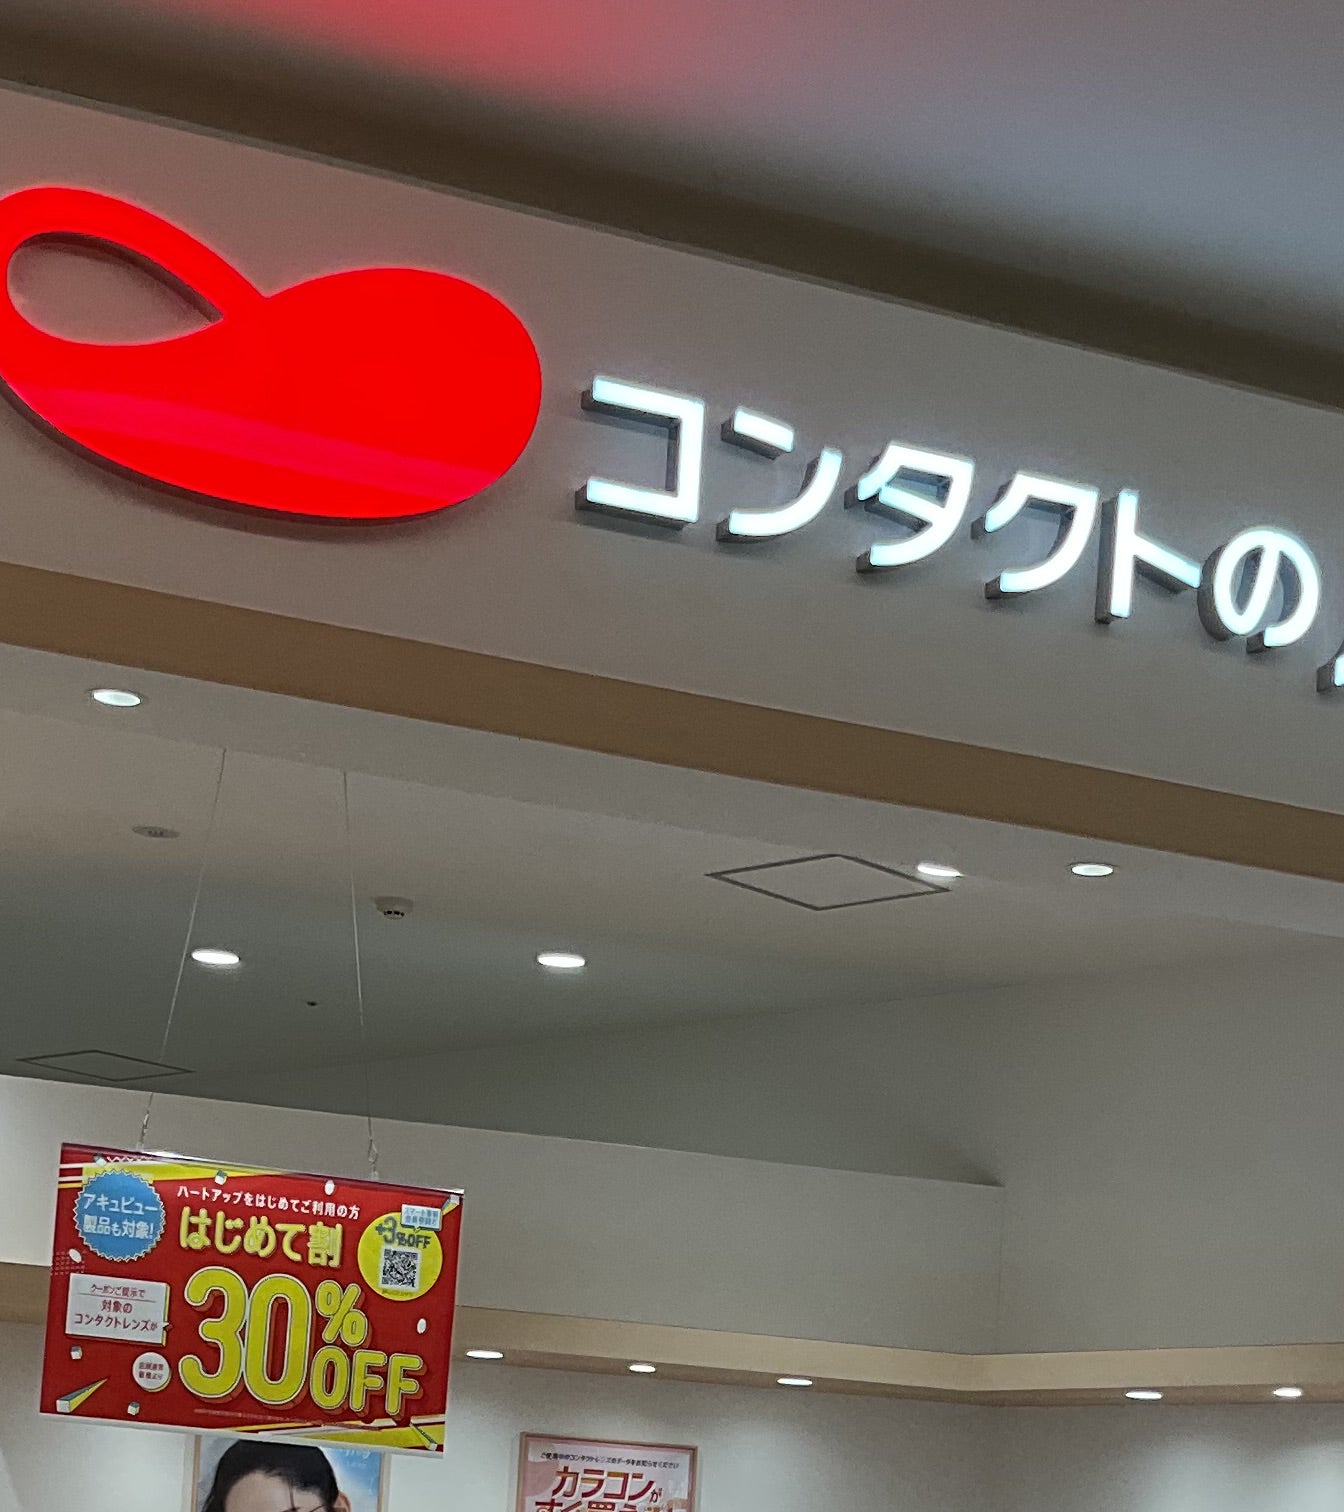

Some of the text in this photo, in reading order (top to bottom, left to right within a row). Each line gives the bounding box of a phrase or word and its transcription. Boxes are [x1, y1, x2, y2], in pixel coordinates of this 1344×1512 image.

[83, 1192, 159, 1216] アキュビュー
[177, 1185, 361, 1221] ハートアップをはじめてご利用の方
[179, 1205, 344, 1269] はじめて割
[100, 1299, 133, 1314] 対象の
[552, 1465, 663, 1503] カラコンが
